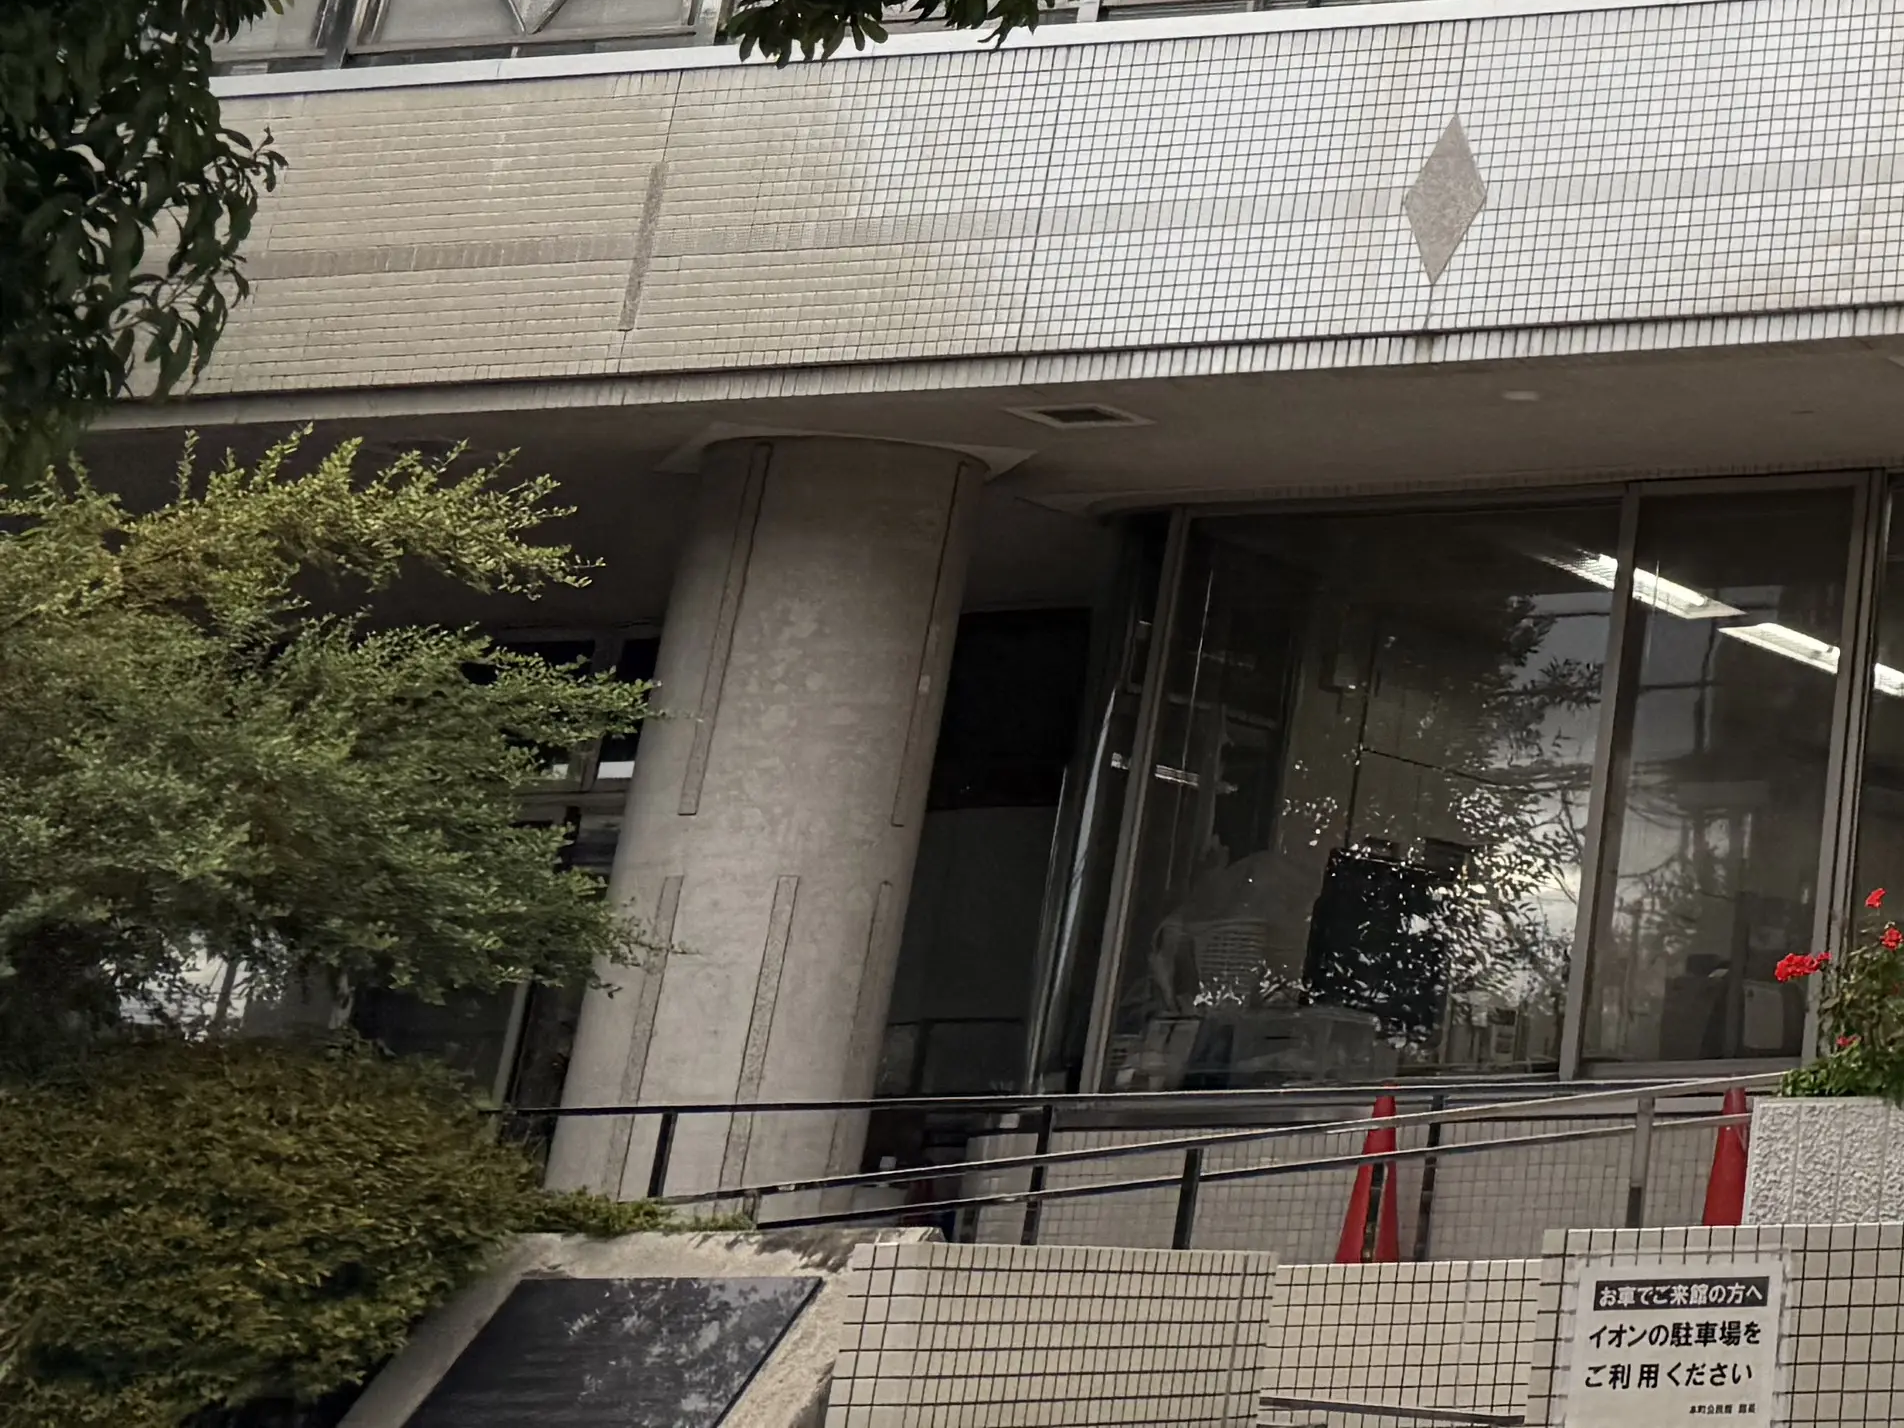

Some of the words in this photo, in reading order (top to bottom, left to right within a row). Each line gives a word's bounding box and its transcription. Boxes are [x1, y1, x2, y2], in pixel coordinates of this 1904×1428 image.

[1599, 1283, 1763, 1308] お車でご来館の方へ
[1589, 1320, 1761, 1349] イオンの駐車場を
[1584, 1362, 1753, 1390] ご利用ください
